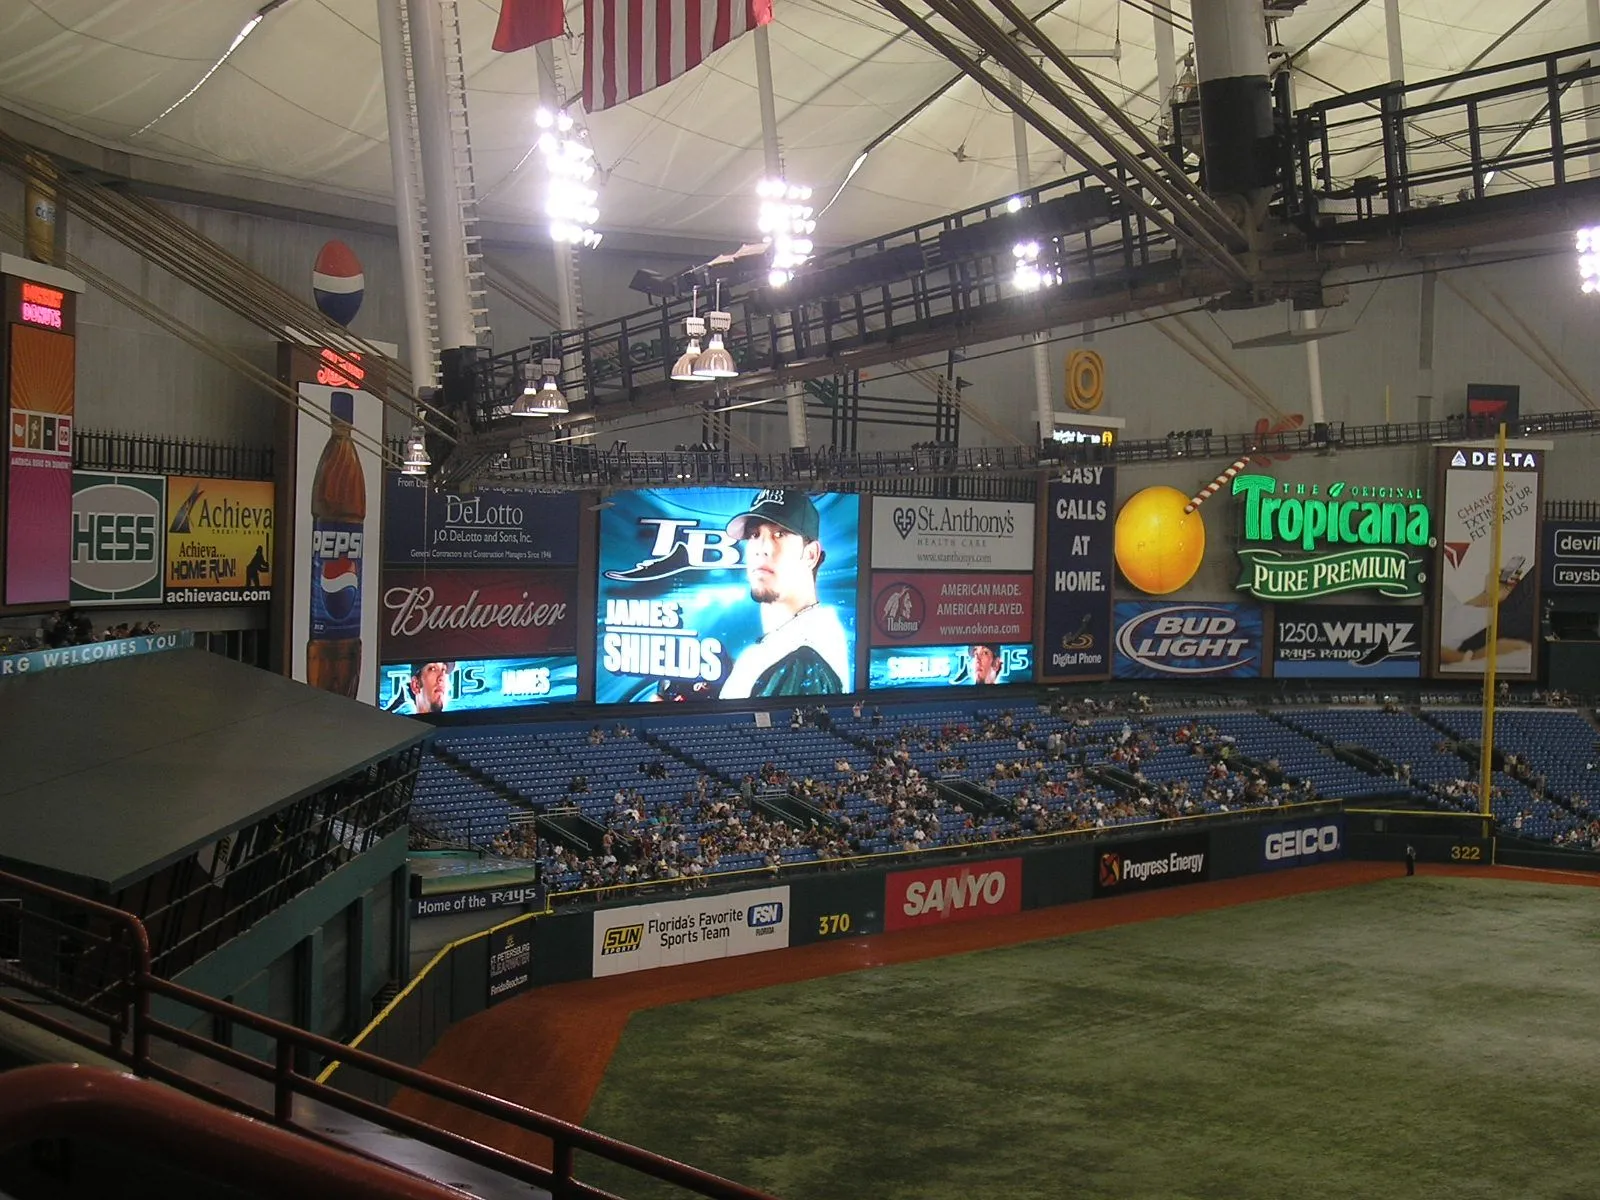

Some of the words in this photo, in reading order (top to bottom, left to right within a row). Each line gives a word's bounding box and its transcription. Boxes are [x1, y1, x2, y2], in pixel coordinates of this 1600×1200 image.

[1472, 451, 1536, 467] DELTA
[1284, 483, 1319, 495] THE
[1352, 487, 1423, 499] ORIGINAL
[198, 498, 273, 529] Achieva
[445, 494, 524, 525] DeLotto
[1056, 498, 1107, 521] CALLS
[1233, 475, 1430, 551] Tropicana
[918, 505, 938, 531] St.
[940, 506, 1015, 539] Anthony's
[72, 512, 155, 563] HESS
[450, 529, 483, 542] DeLotto
[484, 531, 498, 543] and
[917, 538, 956, 547] HEALTH
[961, 539, 987, 548] CARE
[1071, 535, 1090, 556] AT
[170, 559, 207, 581] HOME
[1254, 564, 1309, 593] PURE
[1313, 556, 1406, 590] PREMIUM
[940, 583, 991, 596] AMERICAN
[1055, 571, 1106, 592] HOME.
[166, 588, 271, 603] achievacu.com
[384, 586, 566, 637] Budweiser
[605, 599, 682, 629] JAMES
[936, 602, 987, 616] AMERICAN
[987, 602, 1025, 616] PLAYED.
[939, 621, 1020, 635] www.nokona.com
[1155, 617, 1236, 635] BUD
[1136, 638, 1250, 657] LIGHT
[1279, 622, 1319, 643] 1250
[1322, 621, 1416, 653] WHNZ
[43, 640, 137, 668] WELCOMES
[146, 634, 177, 650] YOU
[603, 632, 722, 682] SHIELDS
[1053, 652, 1077, 667] Digital
[1078, 652, 1102, 665] Phone
[1319, 648, 1361, 659] RADIO
[1265, 825, 1339, 861] GEICO
[1450, 846, 1480, 861] 322
[1123, 858, 1168, 882] Progress
[1170, 852, 1204, 875] Energy
[902, 870, 1006, 917] SANYO
[418, 900, 451, 914] Home
[454, 896, 466, 909] of
[468, 895, 487, 908] the
[752, 903, 778, 924] FSN
[648, 914, 695, 935] Florida's
[699, 908, 744, 925] Favorite
[818, 913, 850, 935] 370
[606, 928, 641, 947] SUN
[660, 930, 698, 949] Sports
[700, 925, 730, 942] Team
[604, 944, 638, 955] SPORTS
